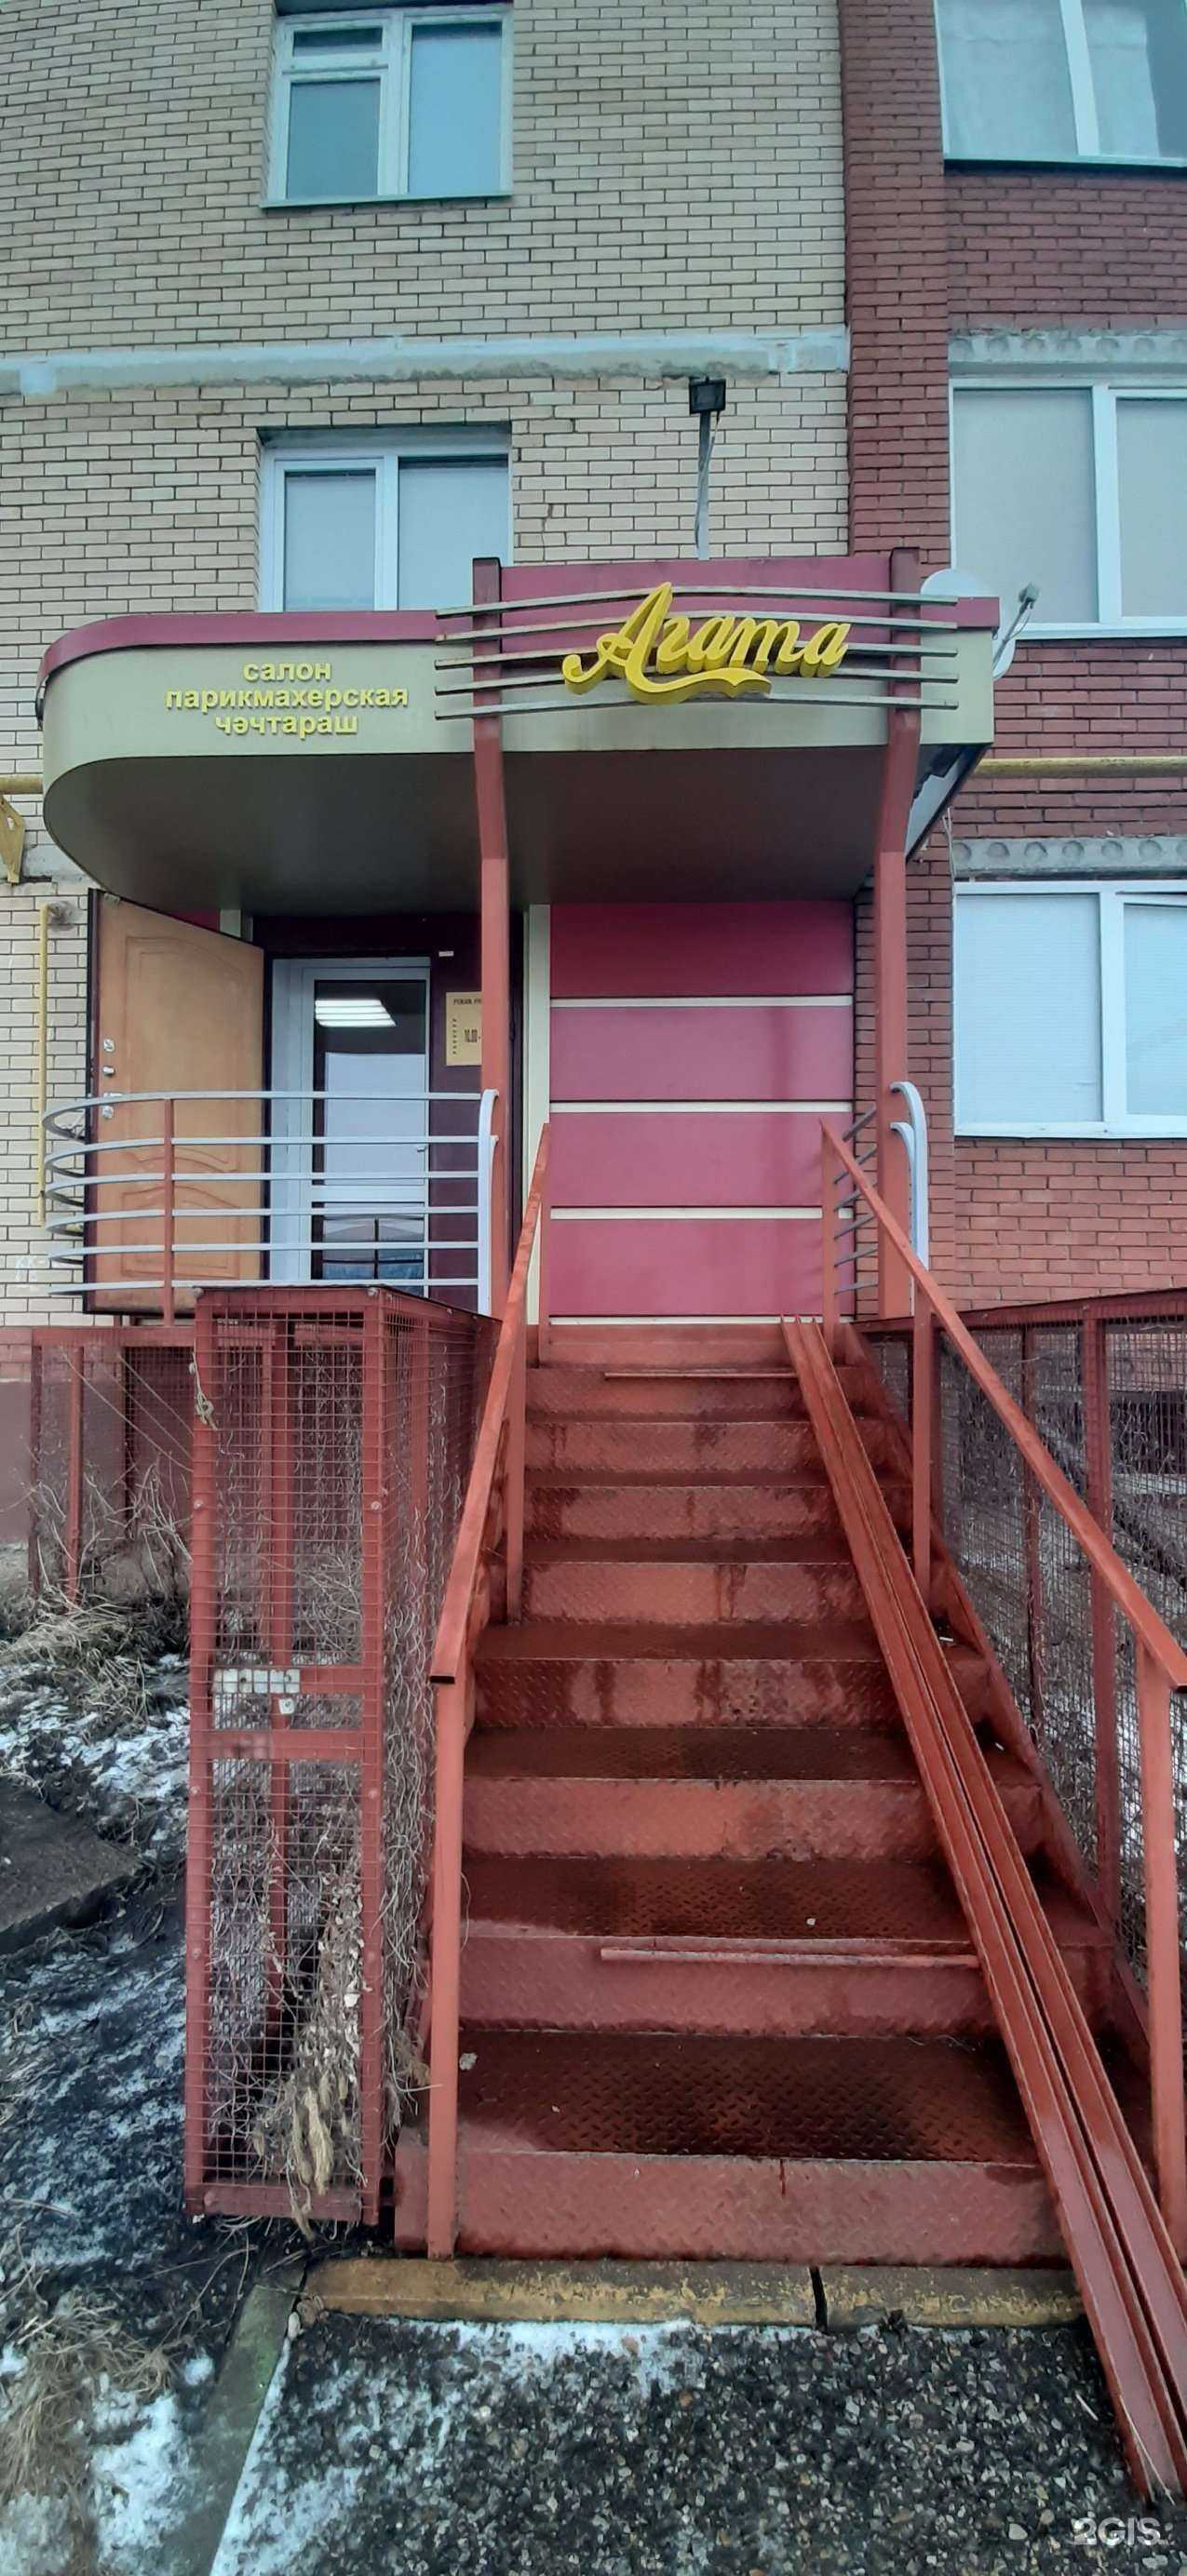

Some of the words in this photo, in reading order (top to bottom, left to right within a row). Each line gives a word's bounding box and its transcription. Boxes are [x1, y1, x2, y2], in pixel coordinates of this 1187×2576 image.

[562, 582, 851, 704] Агата
[243, 662, 331, 681] салон
[165, 687, 409, 714] парикмахерская
